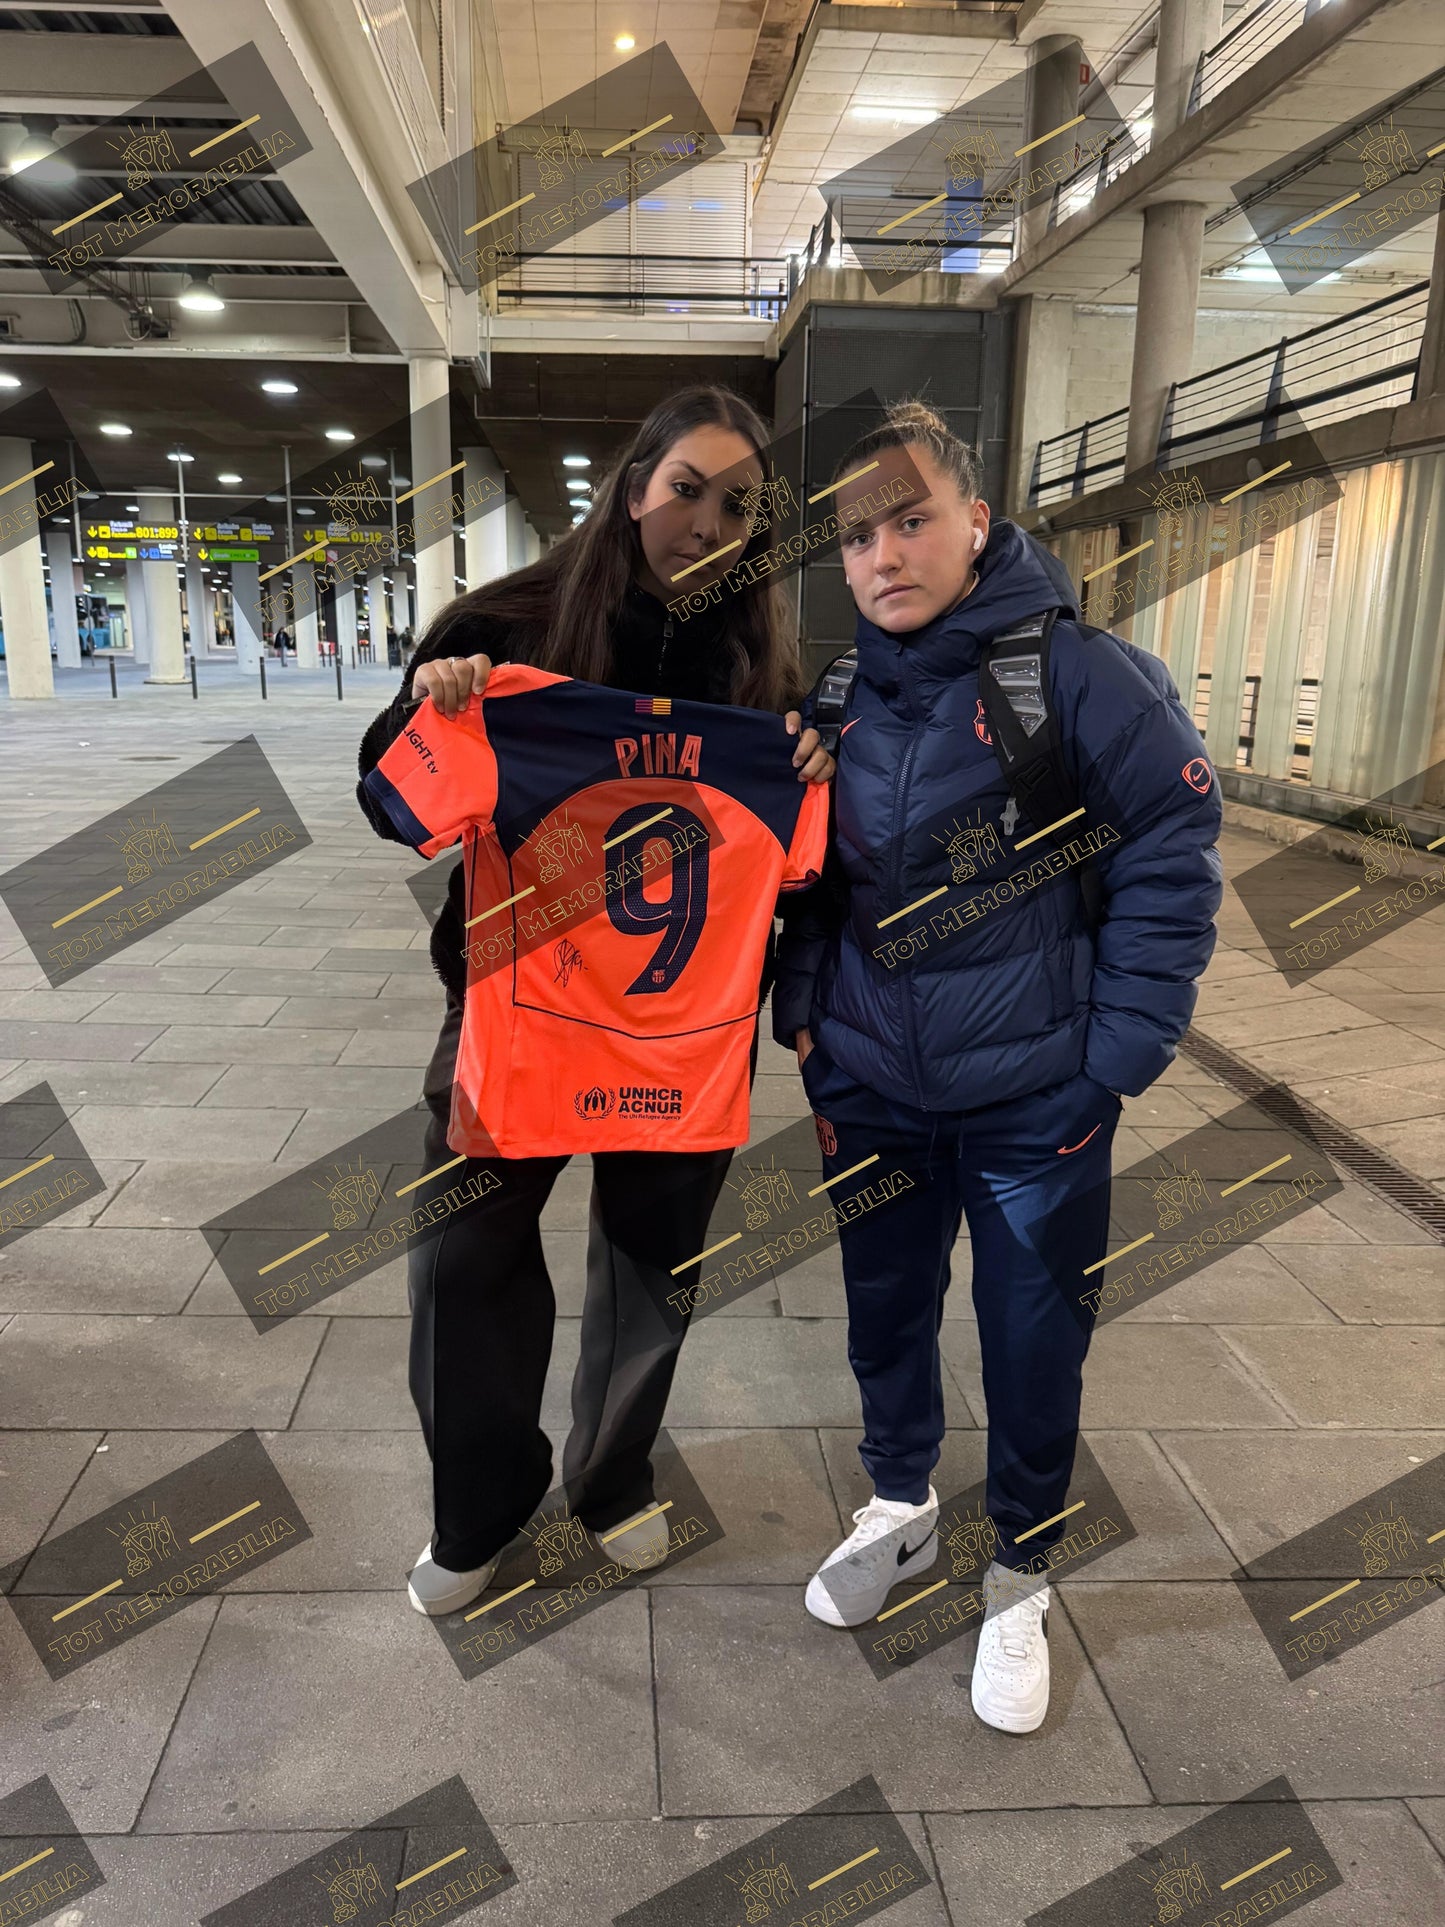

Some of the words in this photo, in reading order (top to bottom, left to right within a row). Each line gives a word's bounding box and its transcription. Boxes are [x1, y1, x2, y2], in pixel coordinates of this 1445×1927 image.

[403, 729, 433, 760] IGHT
[427, 761, 439, 774] tv
[614, 733, 703, 778] PINA
[604, 802, 710, 996] 9
[618, 1100, 682, 1114] ACNUR
[619, 1087, 682, 1101] UNHCR
